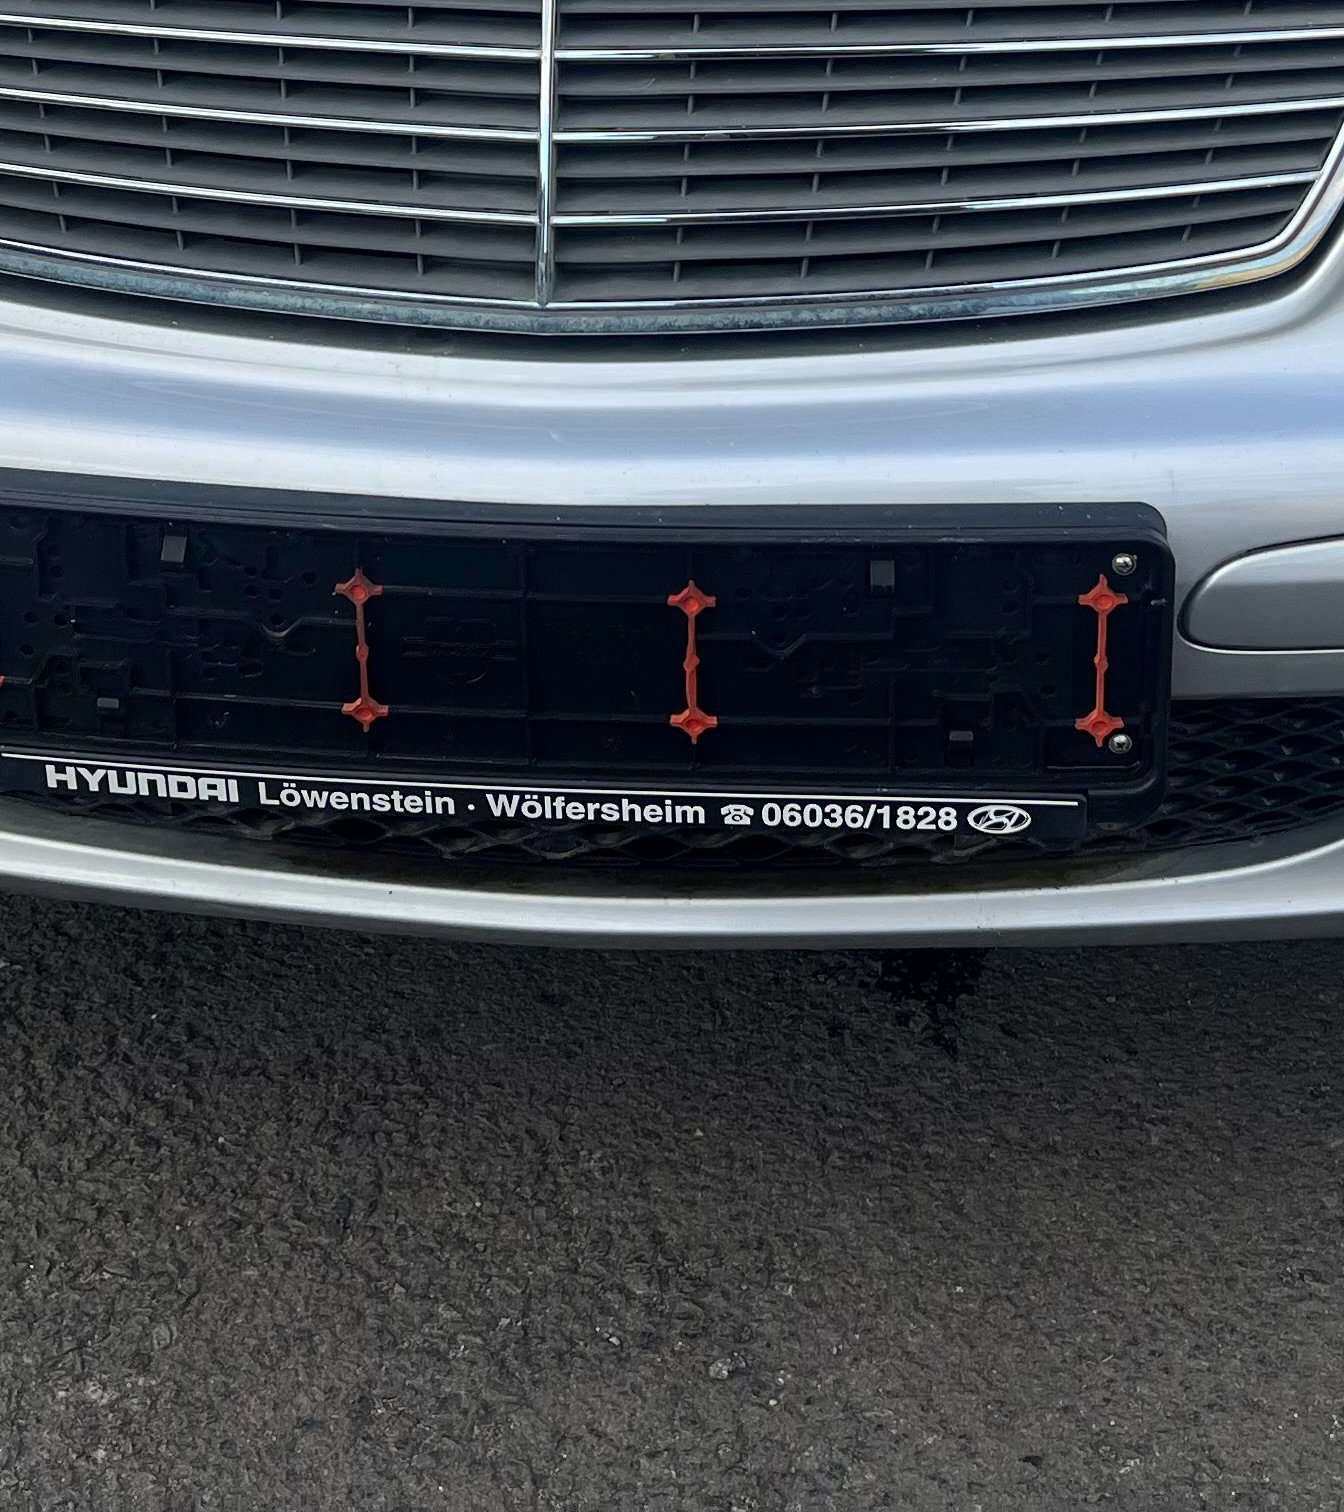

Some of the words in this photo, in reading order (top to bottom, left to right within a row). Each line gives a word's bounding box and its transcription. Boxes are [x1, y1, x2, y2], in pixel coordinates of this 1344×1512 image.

[45, 764, 240, 803] HYUNDAI
[258, 781, 456, 815] Löwenstein
[485, 793, 706, 824] Wölfersheim
[761, 802, 958, 831] 06036/1828
